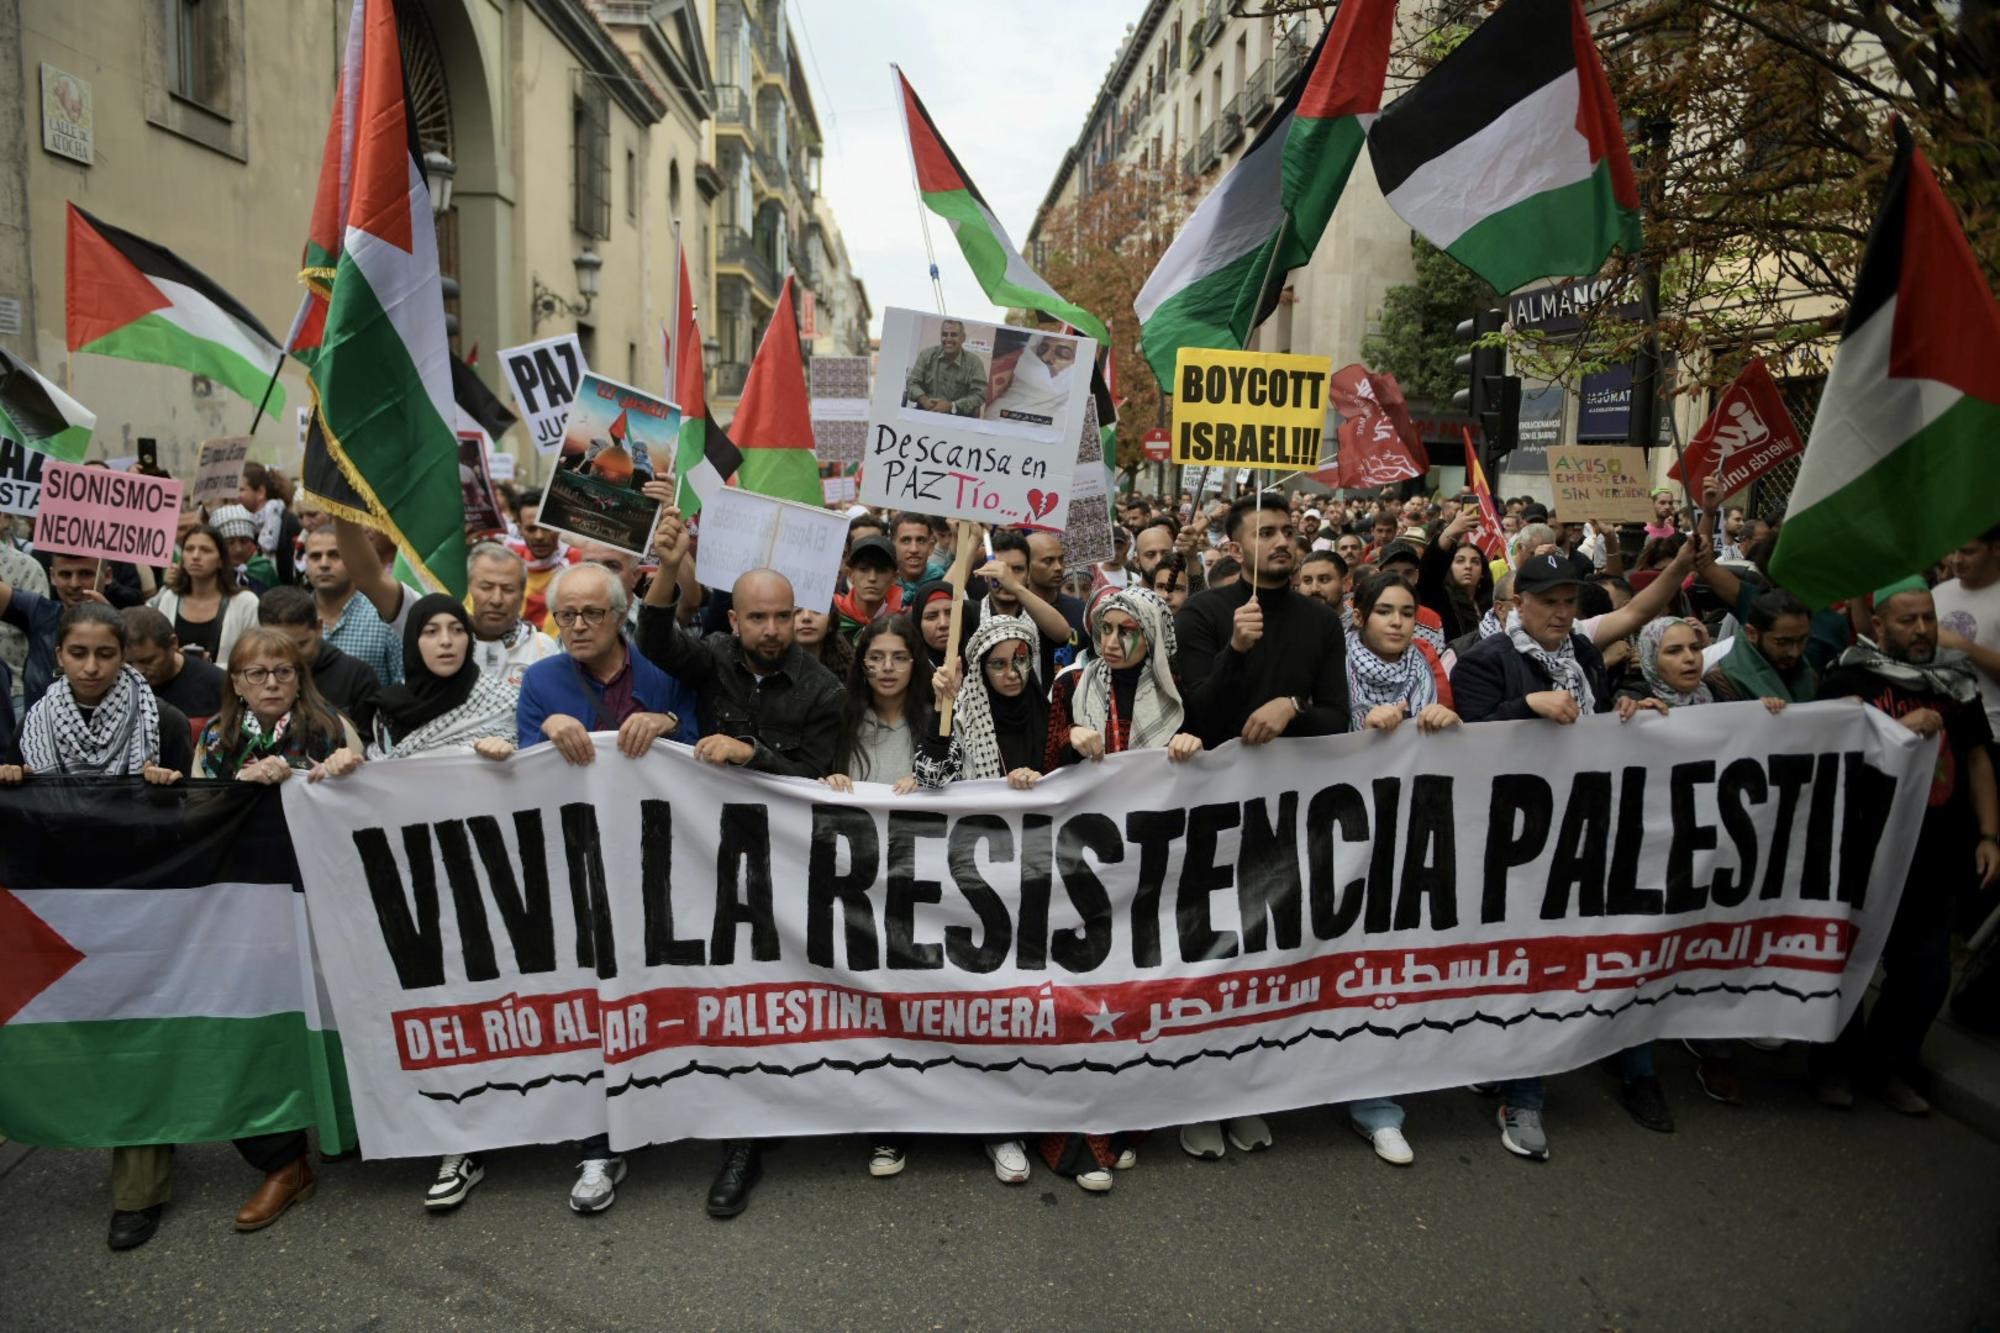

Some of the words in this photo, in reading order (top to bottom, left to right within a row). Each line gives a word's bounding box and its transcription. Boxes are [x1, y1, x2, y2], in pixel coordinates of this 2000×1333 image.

[1182, 364, 1325, 409] BOYCOTT
[874, 424, 1011, 476] Descansa
[1021, 456, 1047, 479] en
[1180, 422, 1321, 466] ISRAEL!!!
[46, 468, 177, 513] SIONISMO=
[884, 460, 948, 501] PAZ
[39, 513, 169, 559] NEONAZISMO.
[640, 799, 782, 968] LA
[806, 773, 1459, 975] RESISTENCIA
[1335, 946, 1530, 1009] فلسطين
[1577, 934, 1682, 991] البحر
[403, 1014, 477, 1062] DEL
[481, 997, 543, 1053] RÍO
[553, 998, 600, 1044] AL
[599, 1002, 648, 1056] AR
[697, 988, 888, 1038] PALESTINA
[900, 984, 1057, 1039] VENCERÁ
[1139, 973, 1321, 1043] ستنتصر
